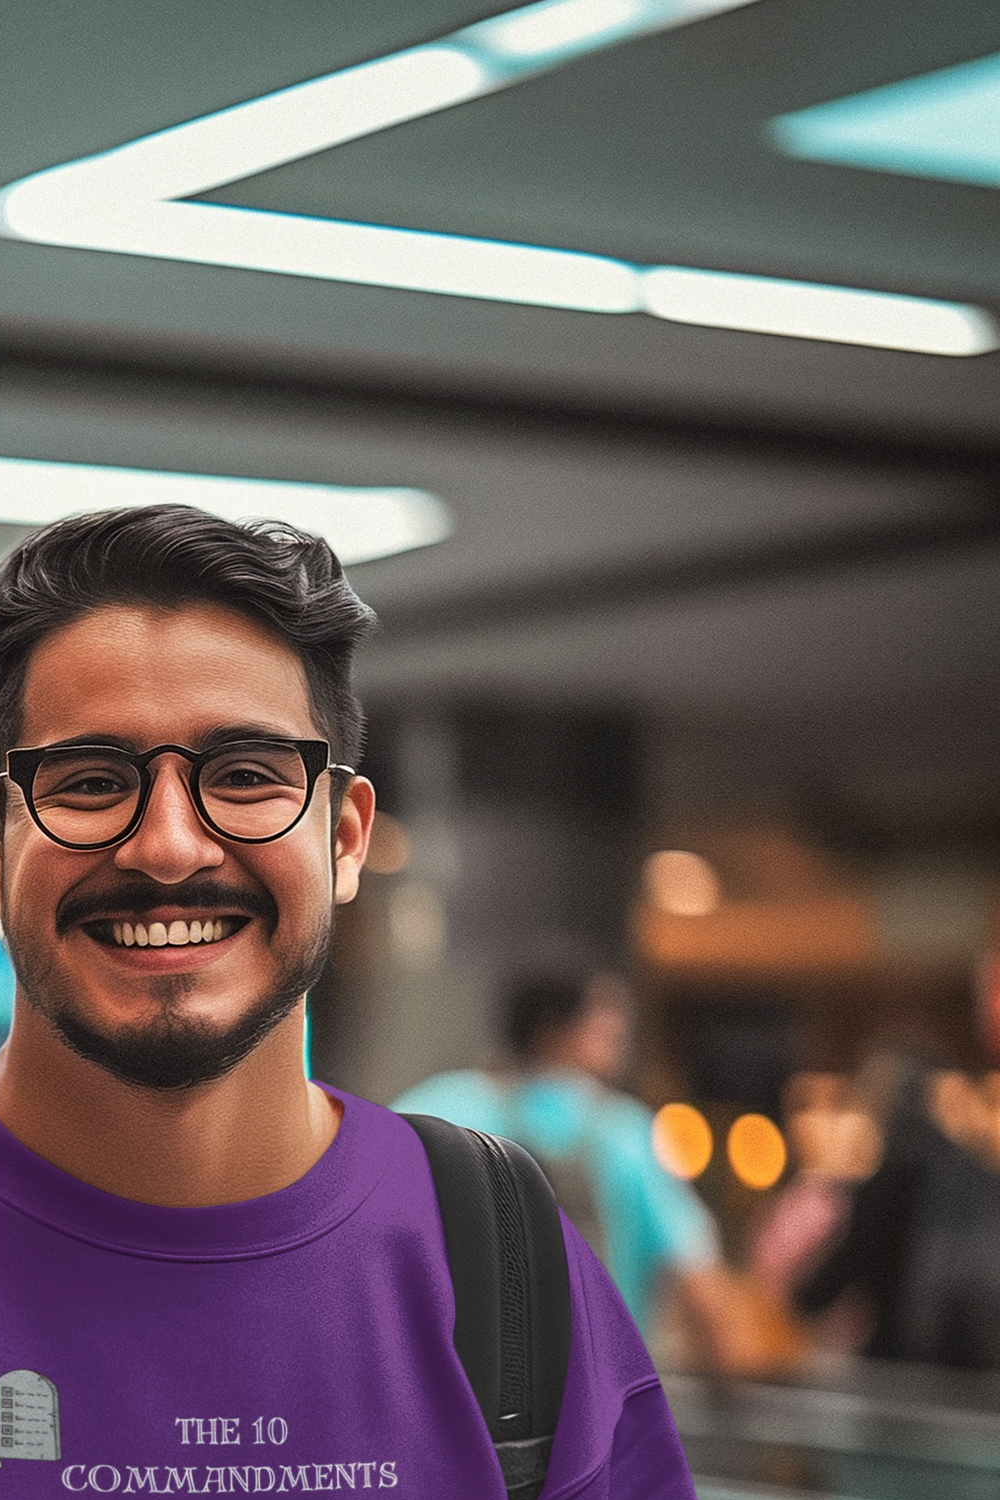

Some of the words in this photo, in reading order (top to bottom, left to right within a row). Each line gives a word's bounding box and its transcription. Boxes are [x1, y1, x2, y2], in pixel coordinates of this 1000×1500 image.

[174, 1416, 241, 1445] THE
[252, 1416, 288, 1445] 10
[61, 1461, 398, 1494] COMMANDMENTS
